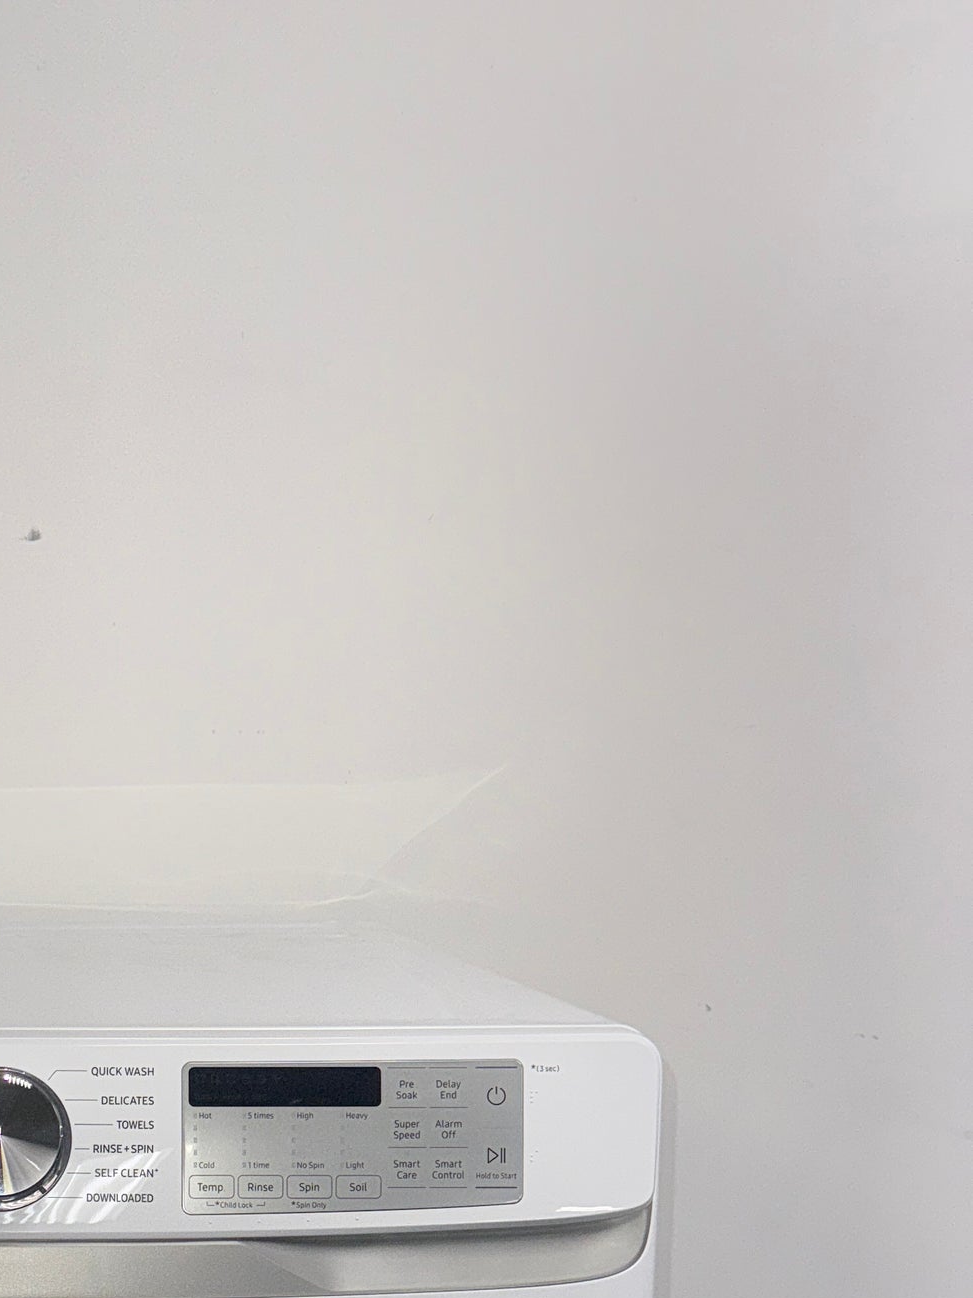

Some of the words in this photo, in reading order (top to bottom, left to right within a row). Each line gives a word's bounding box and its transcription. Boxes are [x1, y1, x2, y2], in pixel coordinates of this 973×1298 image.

[90, 1066, 126, 1077] QUICK
[127, 1066, 154, 1076] WASH
[399, 1080, 414, 1089] Pre
[436, 1080, 461, 1092] Delay
[395, 1090, 417, 1099] Soak
[439, 1090, 456, 1099] End
[100, 1095, 154, 1105] DELICATES
[247, 1111, 252, 1119] 5
[253, 1111, 274, 1119] times
[296, 1111, 313, 1121] High
[345, 1111, 368, 1120] Heavy
[116, 1119, 154, 1129] TOWELS
[394, 1119, 419, 1129] Super
[435, 1120, 462, 1129] Alarm
[393, 1130, 420, 1141] Speed
[441, 1129, 456, 1139] Off
[92, 1143, 122, 1153] RINSE
[130, 1144, 153, 1153] SPIN
[308, 1161, 324, 1170] Spin
[345, 1160, 364, 1170] Light
[393, 1159, 420, 1168] Smart
[434, 1159, 462, 1168] Smart
[94, 1167, 118, 1177] SELF
[396, 1170, 417, 1179] Care
[431, 1170, 464, 1179] Control
[501, 1172, 517, 1180] Start
[197, 1182, 223, 1193] Temp
[247, 1182, 273, 1191] Rinse
[298, 1182, 319, 1193] Spin
[349, 1182, 367, 1191] Soil
[86, 1192, 153, 1203] DOWNLOADED
[238, 1201, 253, 1209] Lock
[311, 1201, 327, 1209] Only
